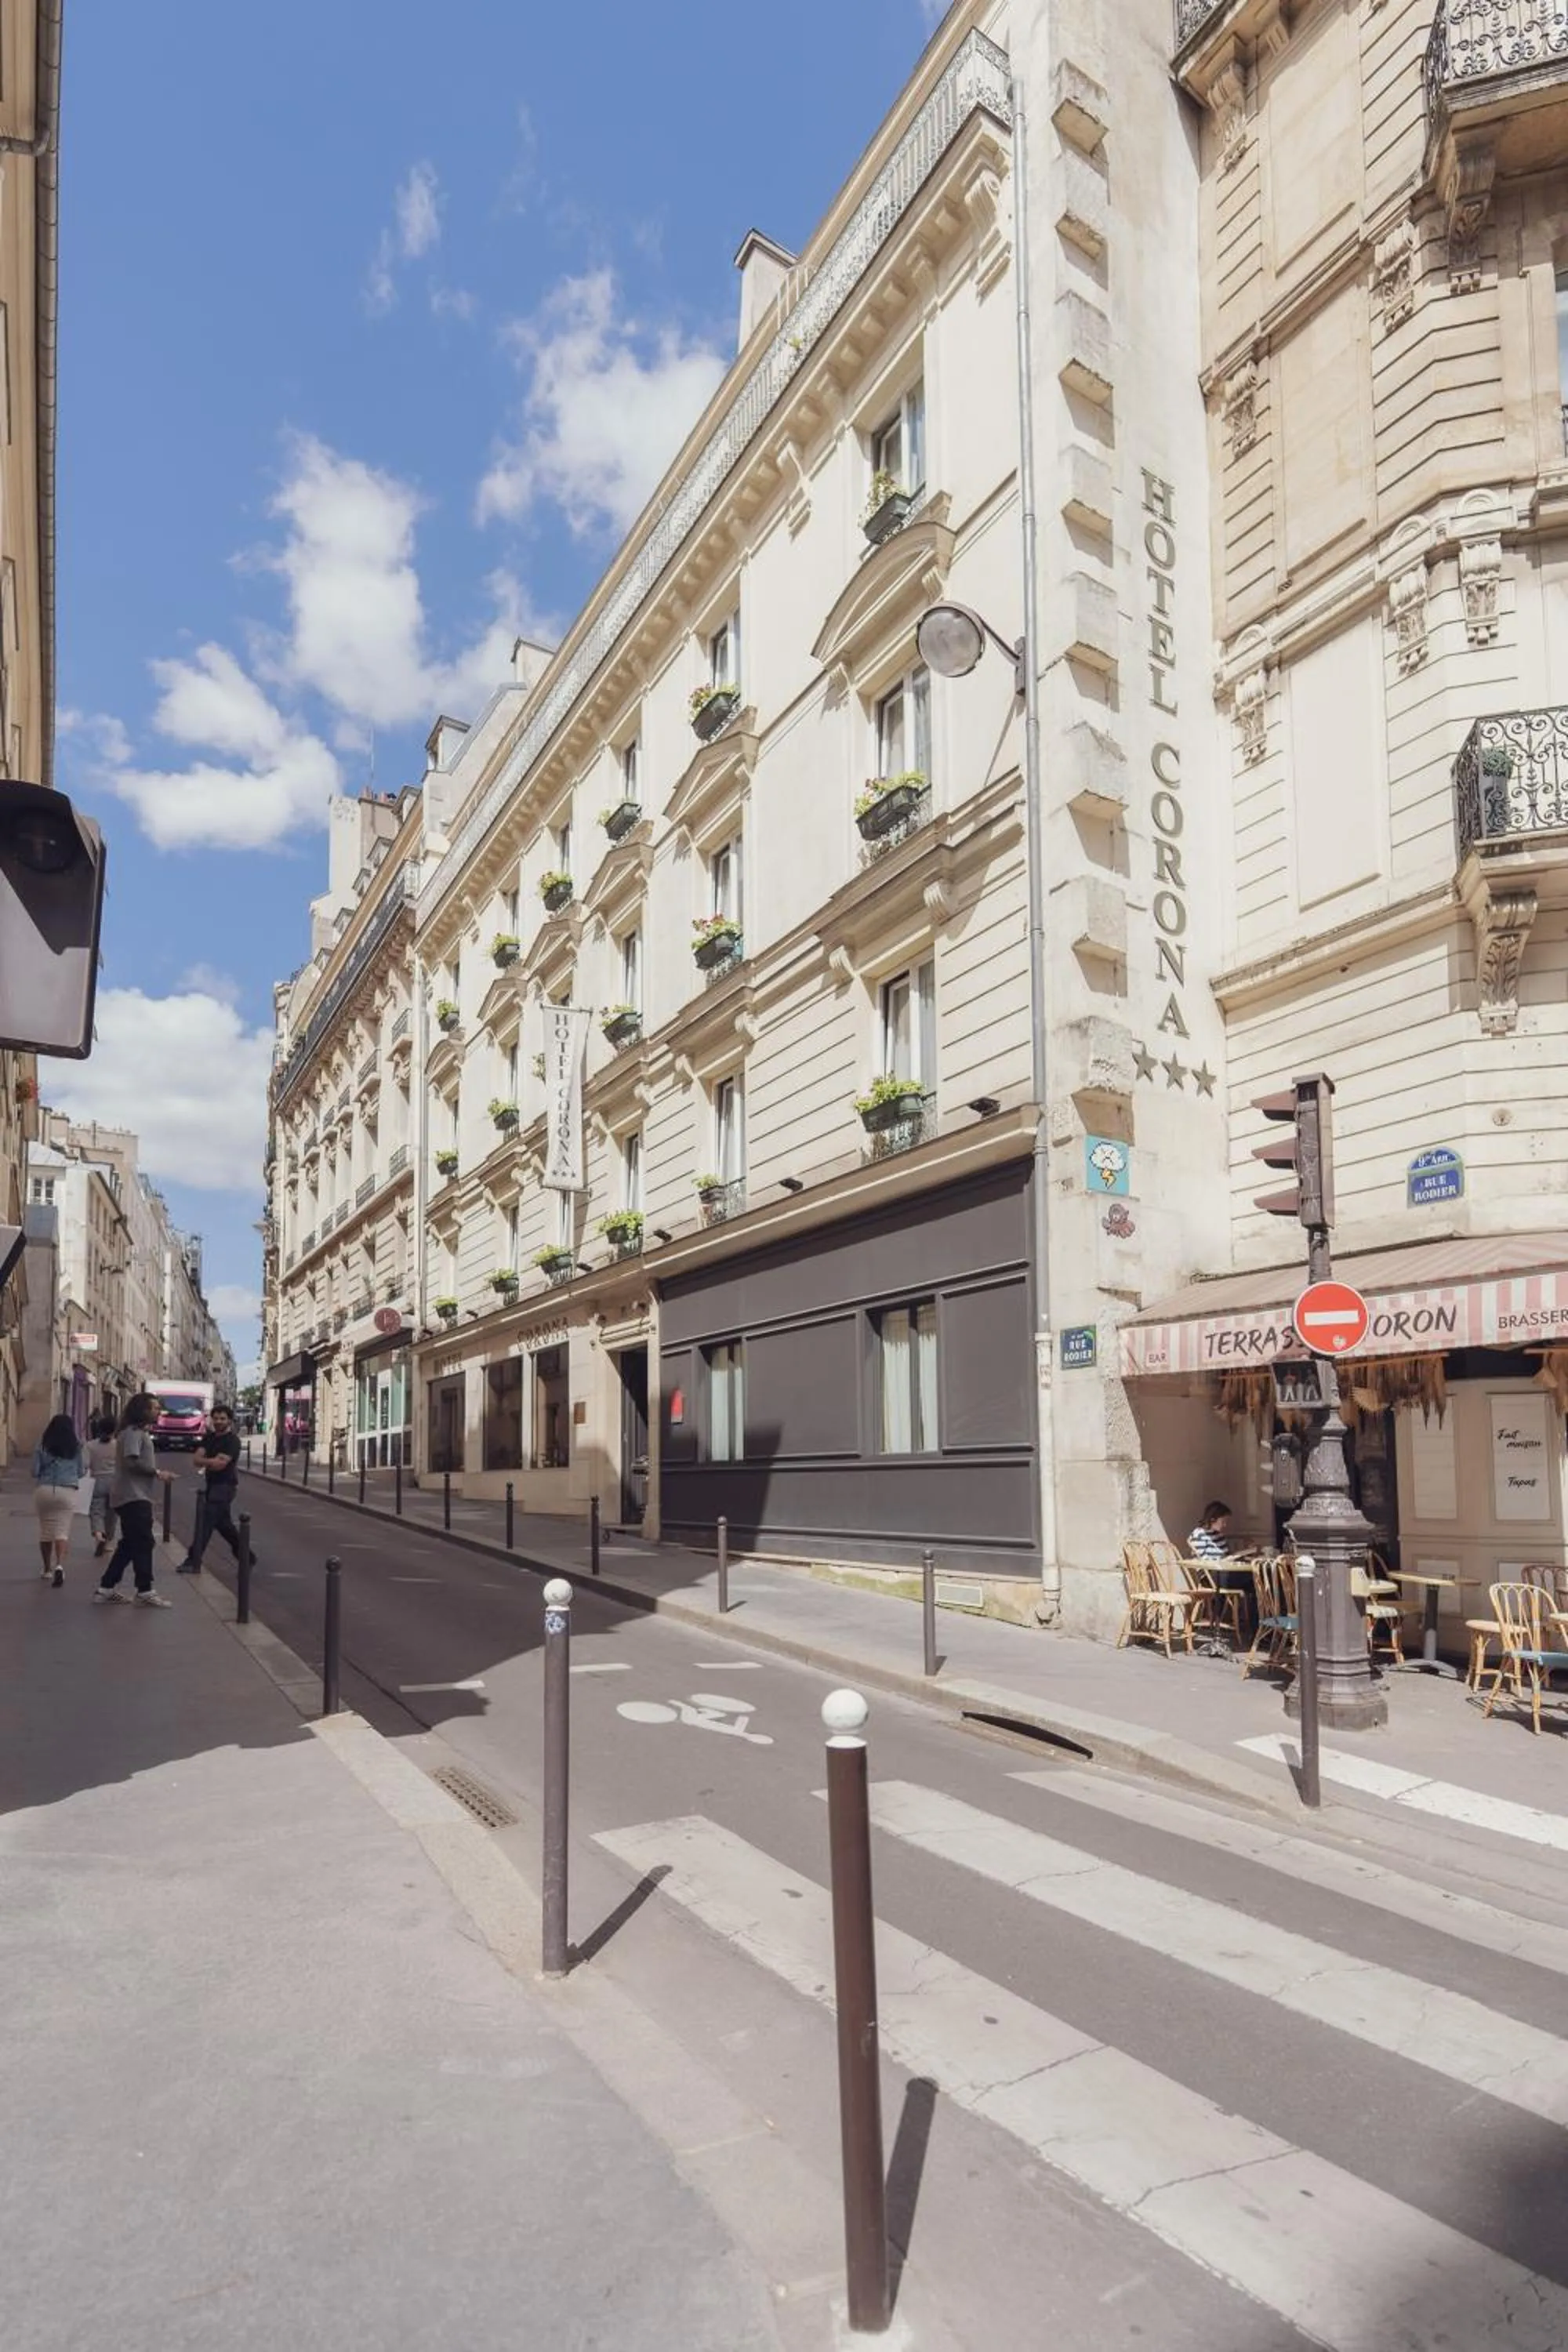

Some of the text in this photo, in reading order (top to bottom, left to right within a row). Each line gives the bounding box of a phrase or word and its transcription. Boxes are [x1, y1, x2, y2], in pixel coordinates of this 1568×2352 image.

[1141, 466, 1190, 1039] HOTEL CORONA
[1149, 1352, 1167, 1363] BAR
[1205, 1305, 1457, 1358] TERRAS ORON
